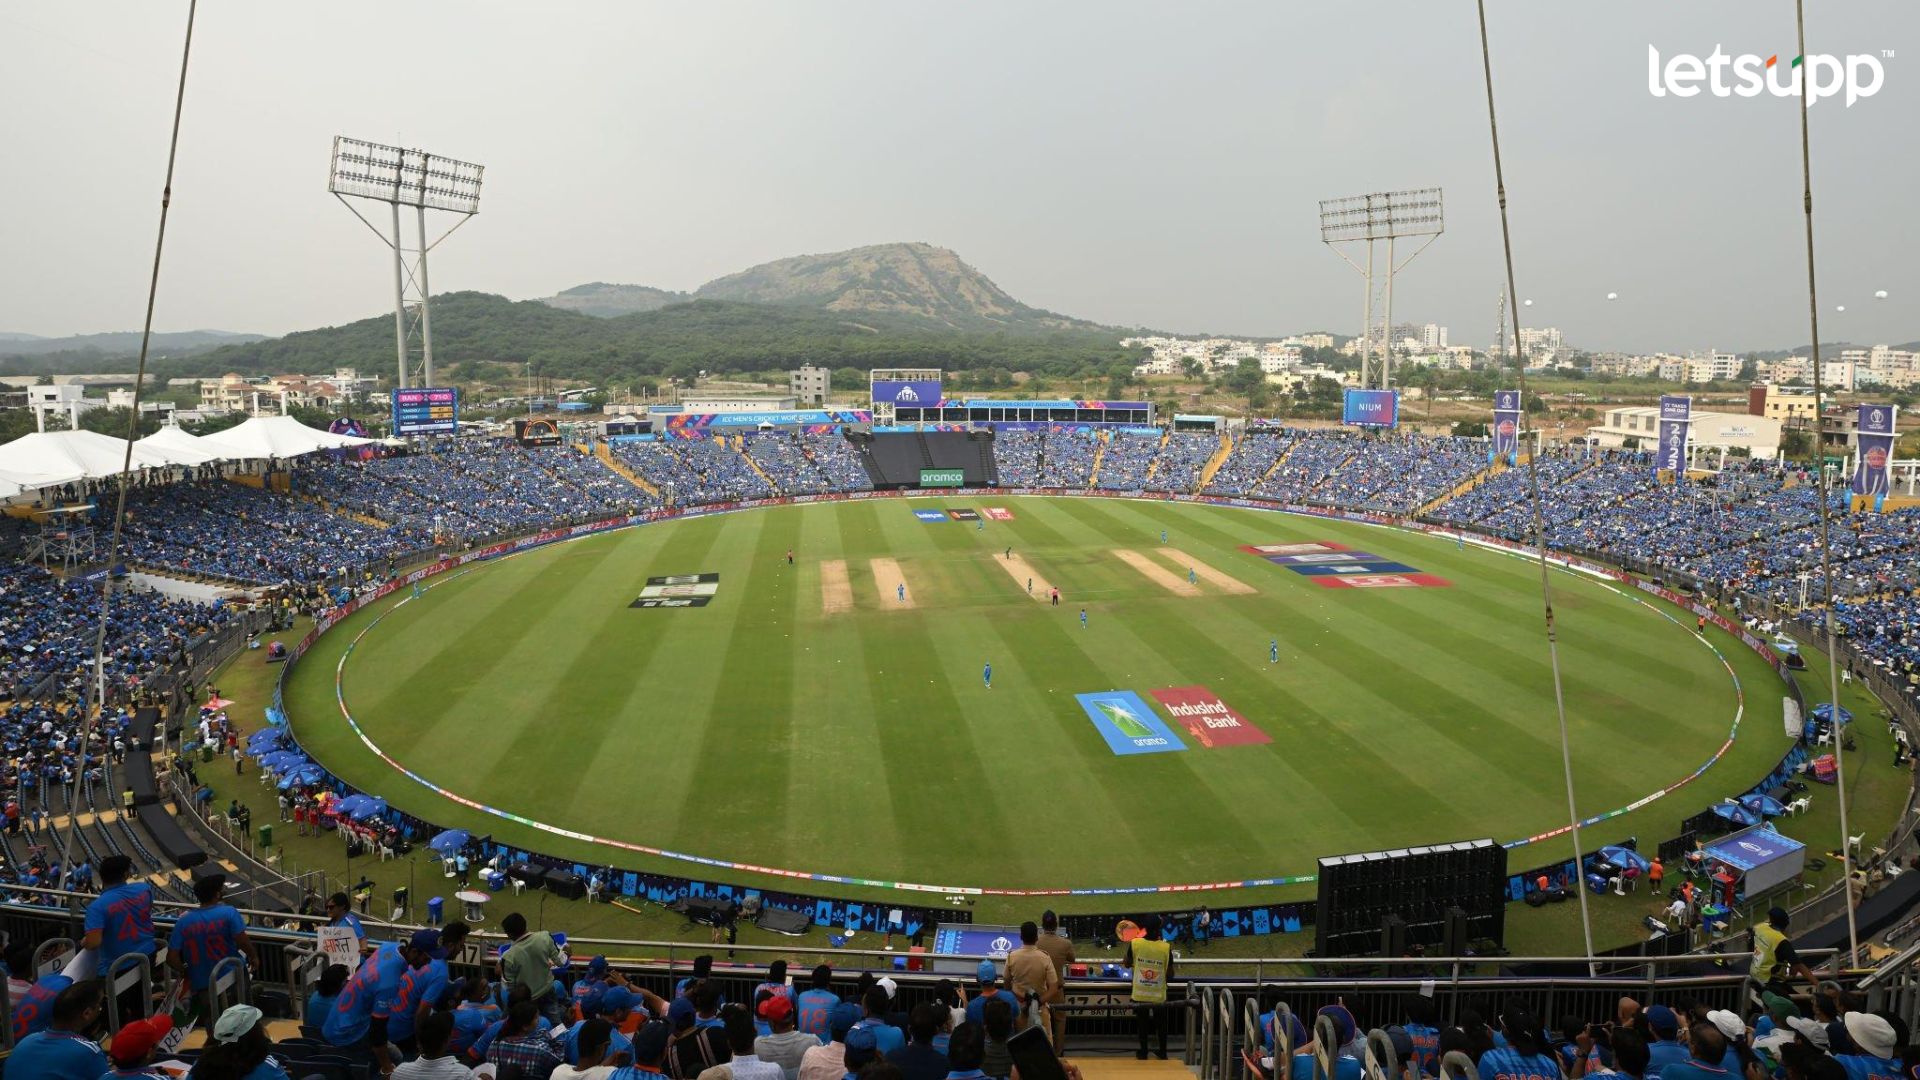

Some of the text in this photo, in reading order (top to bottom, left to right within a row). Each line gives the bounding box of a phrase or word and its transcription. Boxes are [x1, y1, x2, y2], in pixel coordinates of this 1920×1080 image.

[1358, 403, 1382, 411] NIUM
[921, 473, 963, 482] aramco
[1165, 699, 1228, 717] IndusInd
[1203, 715, 1242, 729] Bank
[1133, 735, 1168, 747] aramco
[184, 935, 229, 965] 18
[323, 937, 352, 953] भारत
[462, 944, 478, 963] 17
[52, 959, 62, 971] D
[1090, 1008, 1128, 1016] BAY BAY
[801, 1008, 828, 1035] 18
